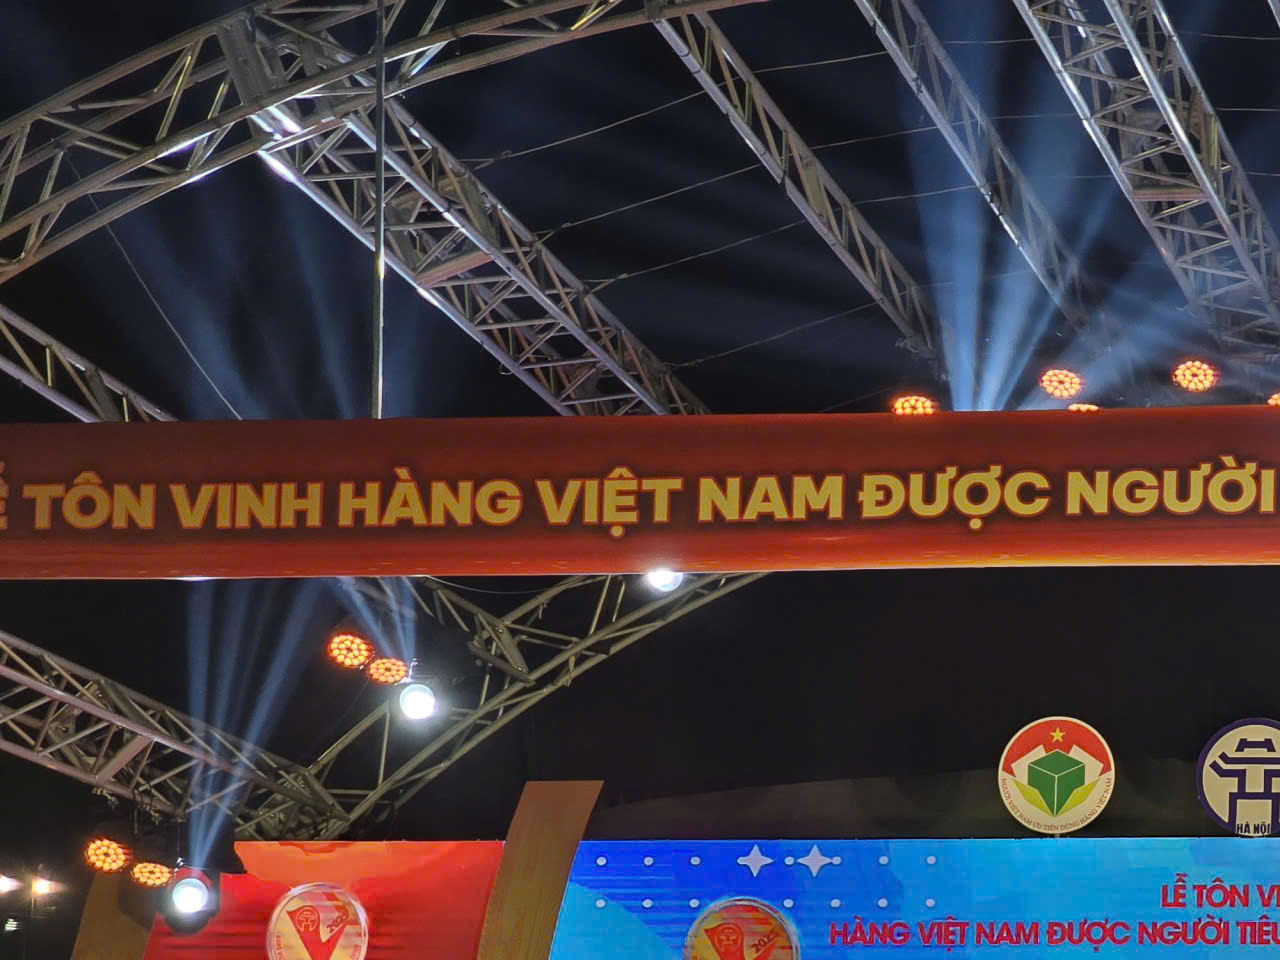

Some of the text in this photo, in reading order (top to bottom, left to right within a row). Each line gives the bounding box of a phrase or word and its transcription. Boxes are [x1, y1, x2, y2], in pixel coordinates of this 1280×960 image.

[22, 470, 157, 530] TÔN
[169, 480, 320, 529] VINH
[339, 468, 521, 528] HÀNG
[535, 466, 682, 538] VIỆT
[698, 473, 843, 523] NAM
[858, 463, 1051, 530] ĐƯỢC
[1066, 454, 1274, 516] NGƯỜI
[1236, 821, 1271, 837] HÀ NỘI
[1161, 873, 1187, 909] LỄ
[1193, 878, 1249, 909] TÔN
[829, 915, 909, 945] HÀNG
[919, 915, 968, 953] VIỆT
[975, 921, 1039, 945] NAM
[1046, 920, 1130, 953] ĐƯỢC
[1137, 914, 1230, 945] NGƯỜI
